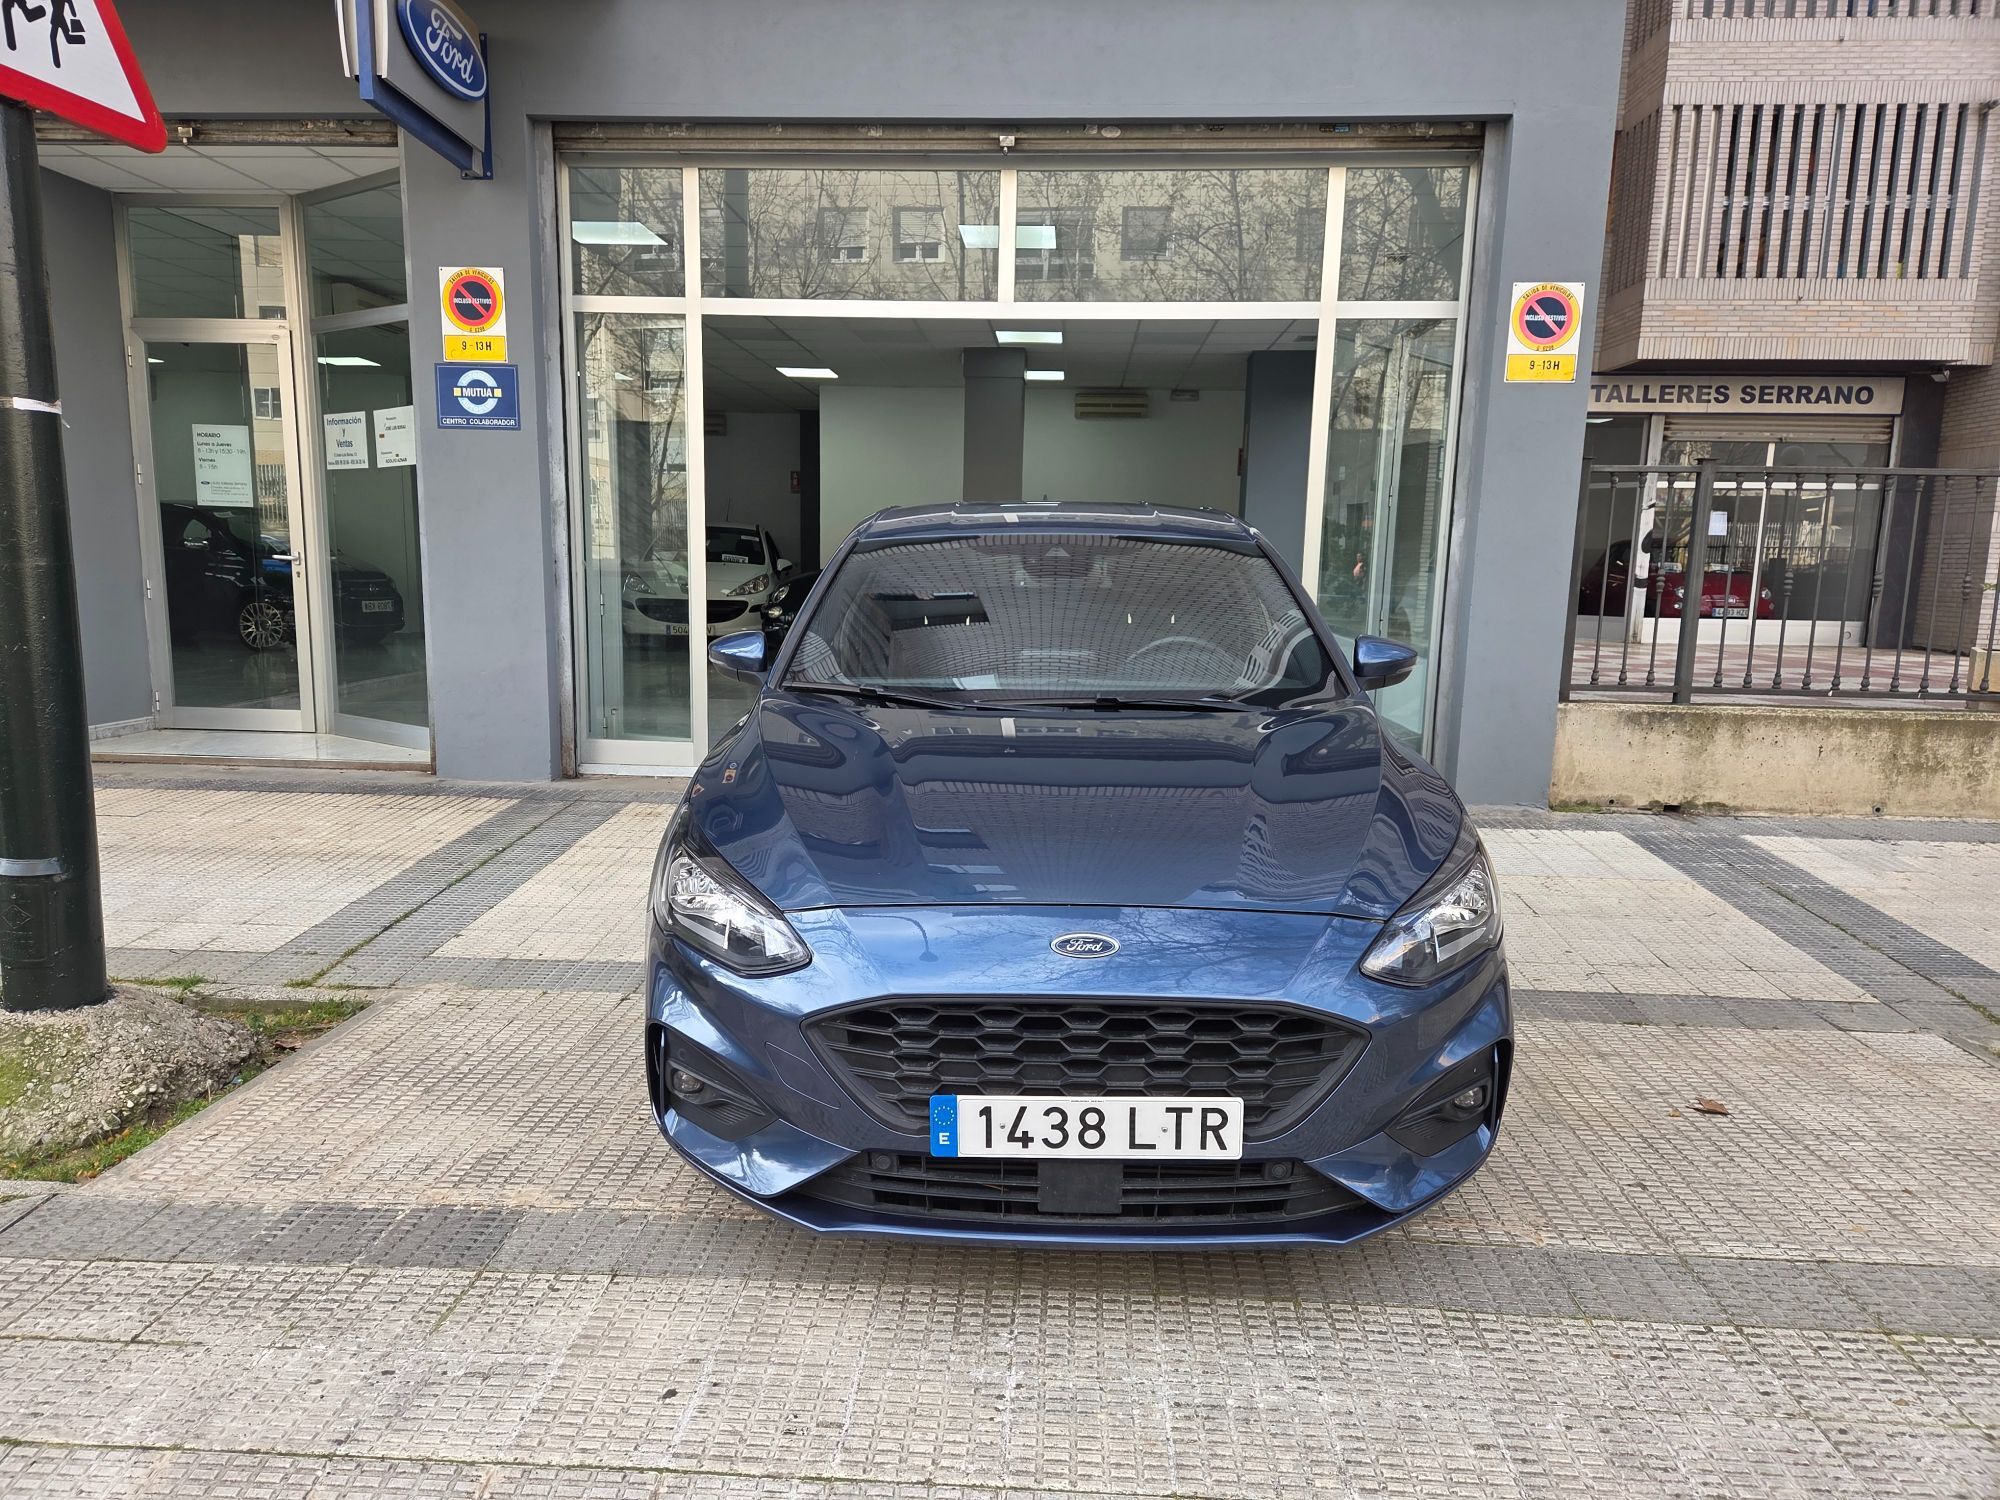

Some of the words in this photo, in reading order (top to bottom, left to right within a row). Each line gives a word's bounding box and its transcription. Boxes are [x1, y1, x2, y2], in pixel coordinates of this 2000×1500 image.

[426, 8, 474, 84] Ford
[449, 272, 464, 285] SALIDA
[1522, 287, 1540, 301] SALIDA
[472, 297, 492, 305] FESTIVOS
[1547, 314, 1568, 322] FESTIVOS
[462, 387, 493, 398] MUTUA
[1590, 384, 1730, 405] TALLERES
[1739, 385, 1875, 405] SERRANO
[326, 416, 362, 426] Información
[442, 417, 467, 425] CENTRO
[469, 418, 516, 426] COLABORADOR
[341, 428, 346, 438] y
[335, 439, 353, 449] Ventas
[1066, 938, 1104, 952] Ford
[938, 1132, 950, 1145] E
[978, 1105, 1106, 1150] 1438
[1129, 1106, 1229, 1151] LTR
